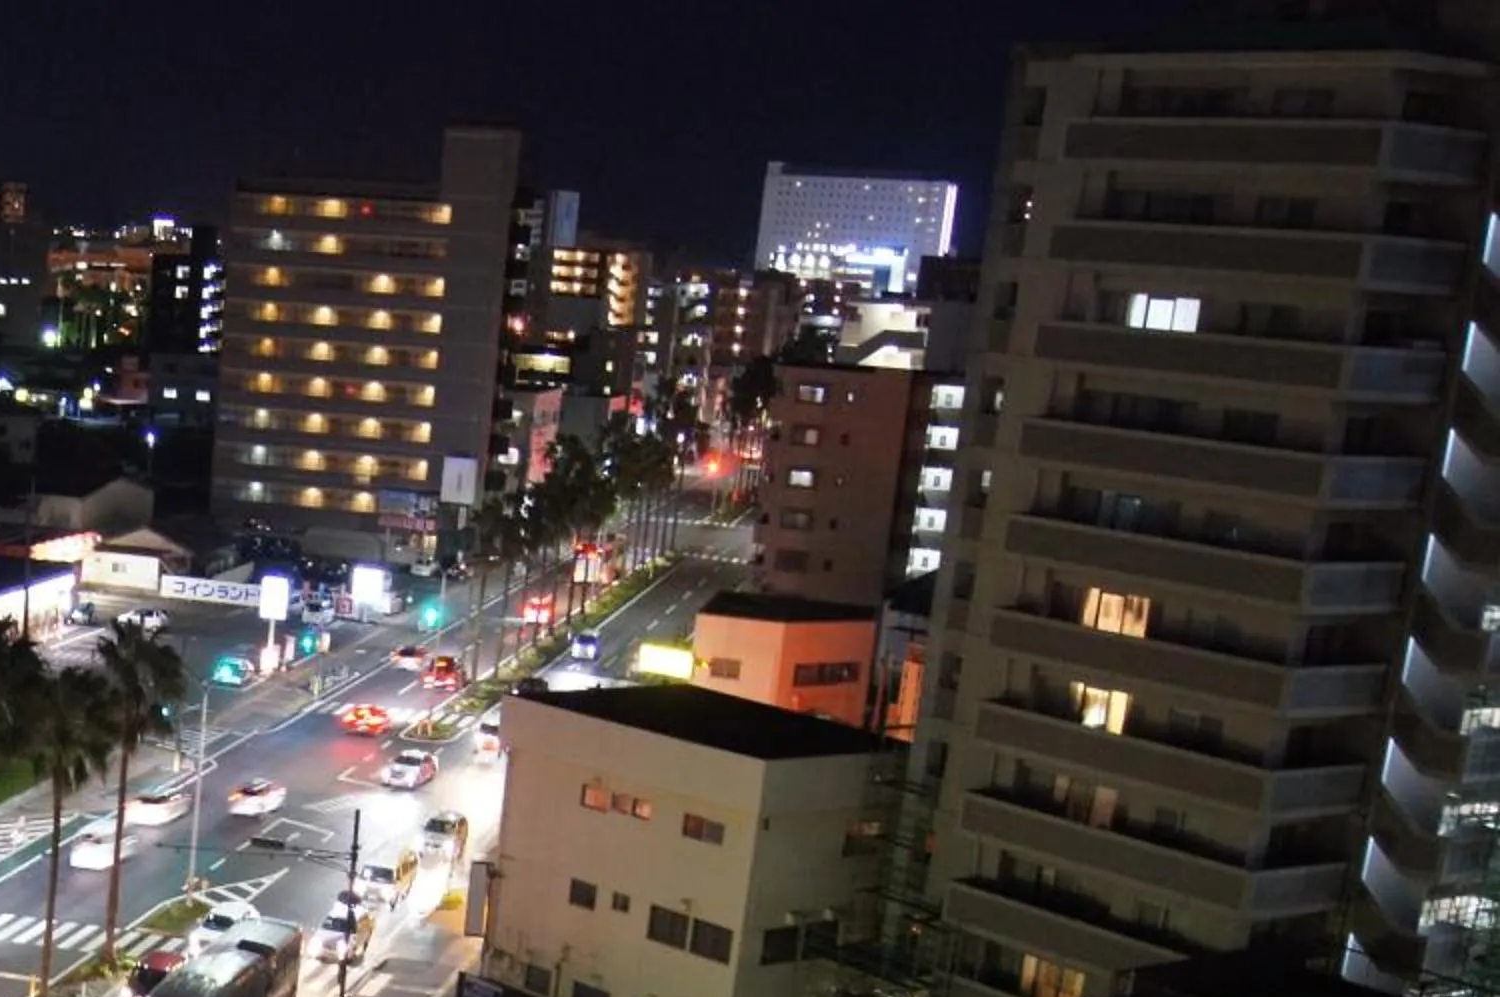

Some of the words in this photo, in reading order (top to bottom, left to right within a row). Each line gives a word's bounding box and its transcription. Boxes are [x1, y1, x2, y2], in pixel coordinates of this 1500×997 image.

[173, 580, 260, 601] コインランド
